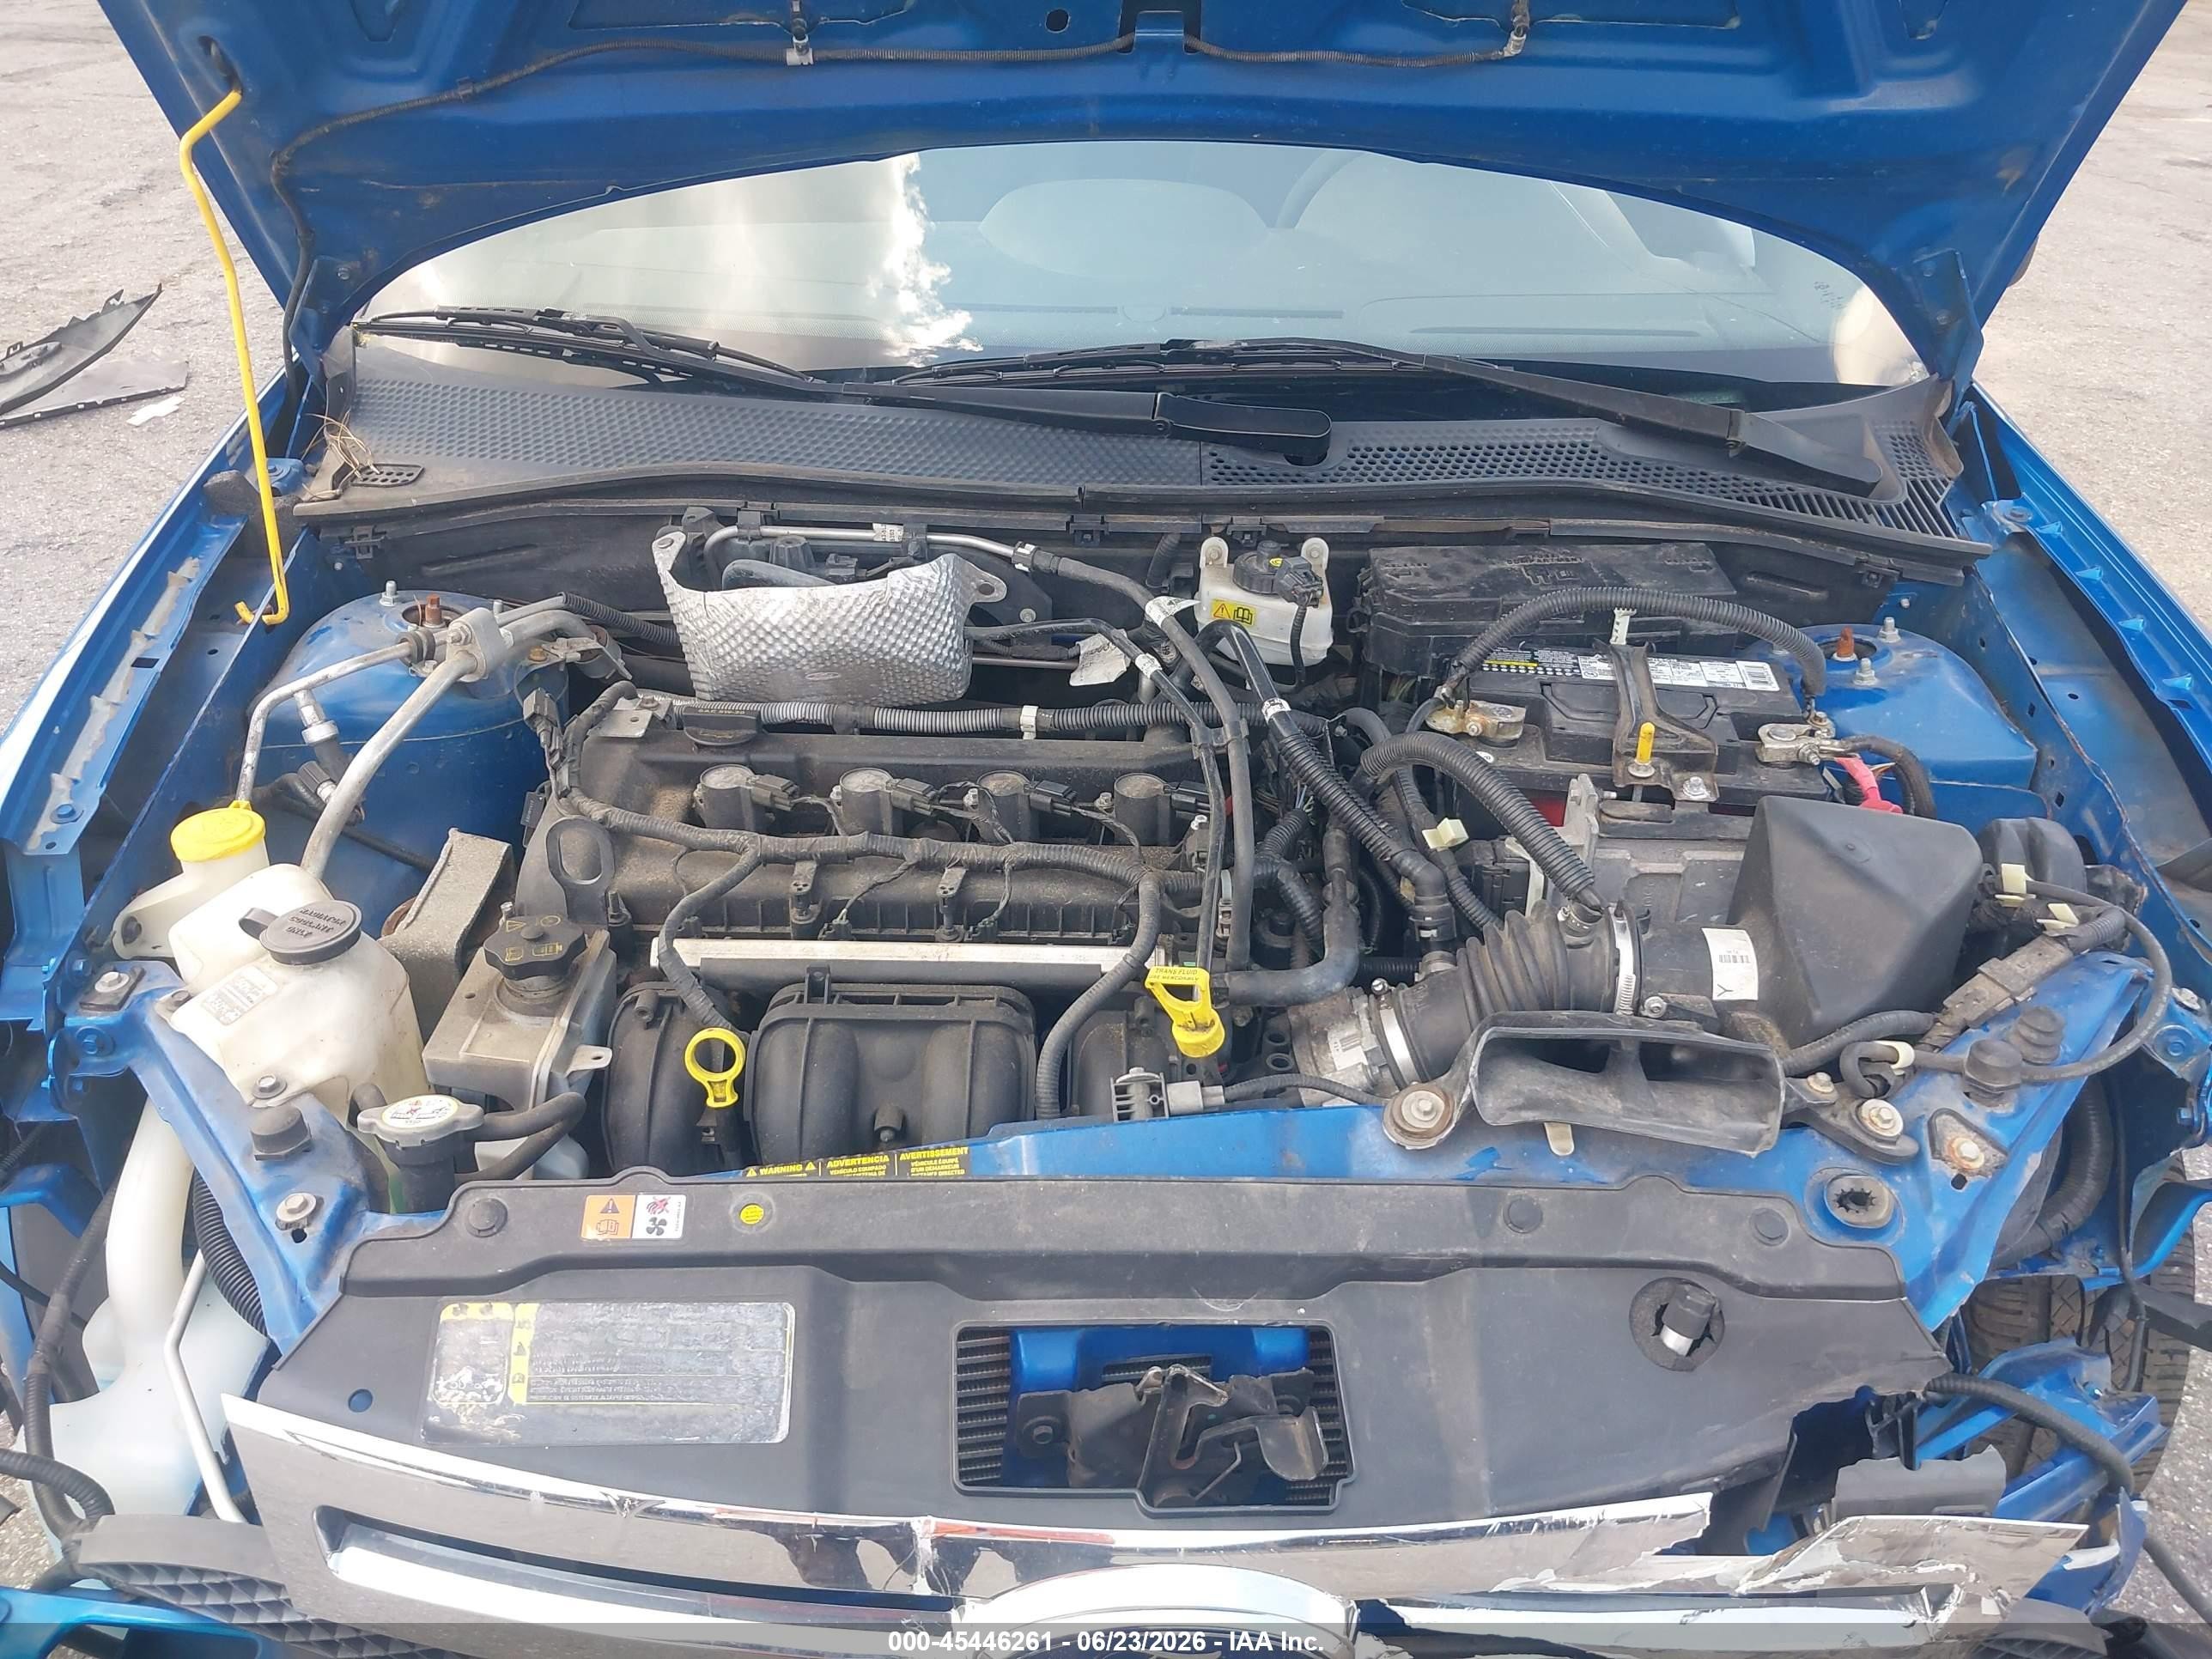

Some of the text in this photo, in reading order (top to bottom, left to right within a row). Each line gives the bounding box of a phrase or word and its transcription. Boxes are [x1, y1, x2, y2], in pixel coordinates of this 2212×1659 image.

[286, 926, 313, 937] ONLY
[899, 1147, 969, 1161] AVERTISSEMENT
[826, 1155, 890, 1169] ADVERTENCIA
[759, 1164, 803, 1176] WARNING
